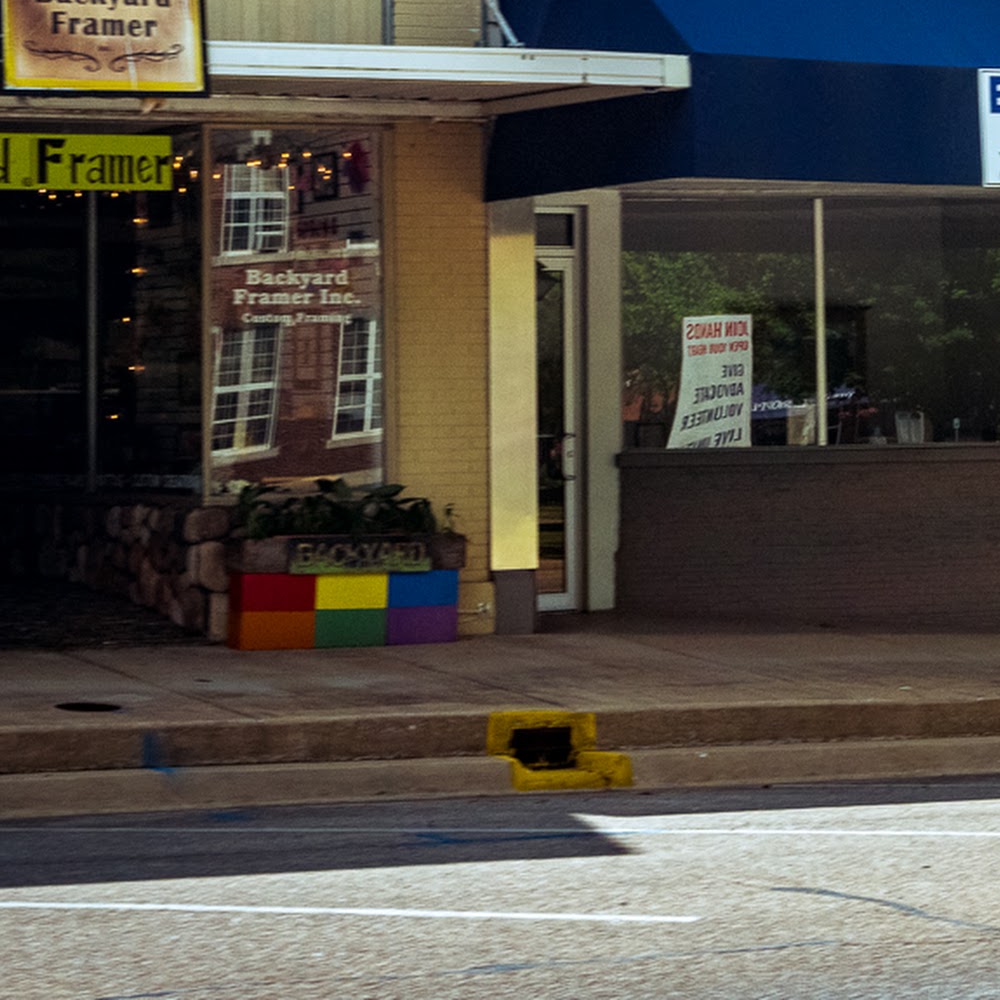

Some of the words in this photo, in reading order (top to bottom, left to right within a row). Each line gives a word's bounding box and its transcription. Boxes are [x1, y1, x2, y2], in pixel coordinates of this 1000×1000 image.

[51, 11, 157, 37] Framer
[37, 139, 171, 184] Framer
[246, 269, 348, 289] Backyard
[232, 289, 315, 305] Framer
[320, 289, 362, 304] Inc.
